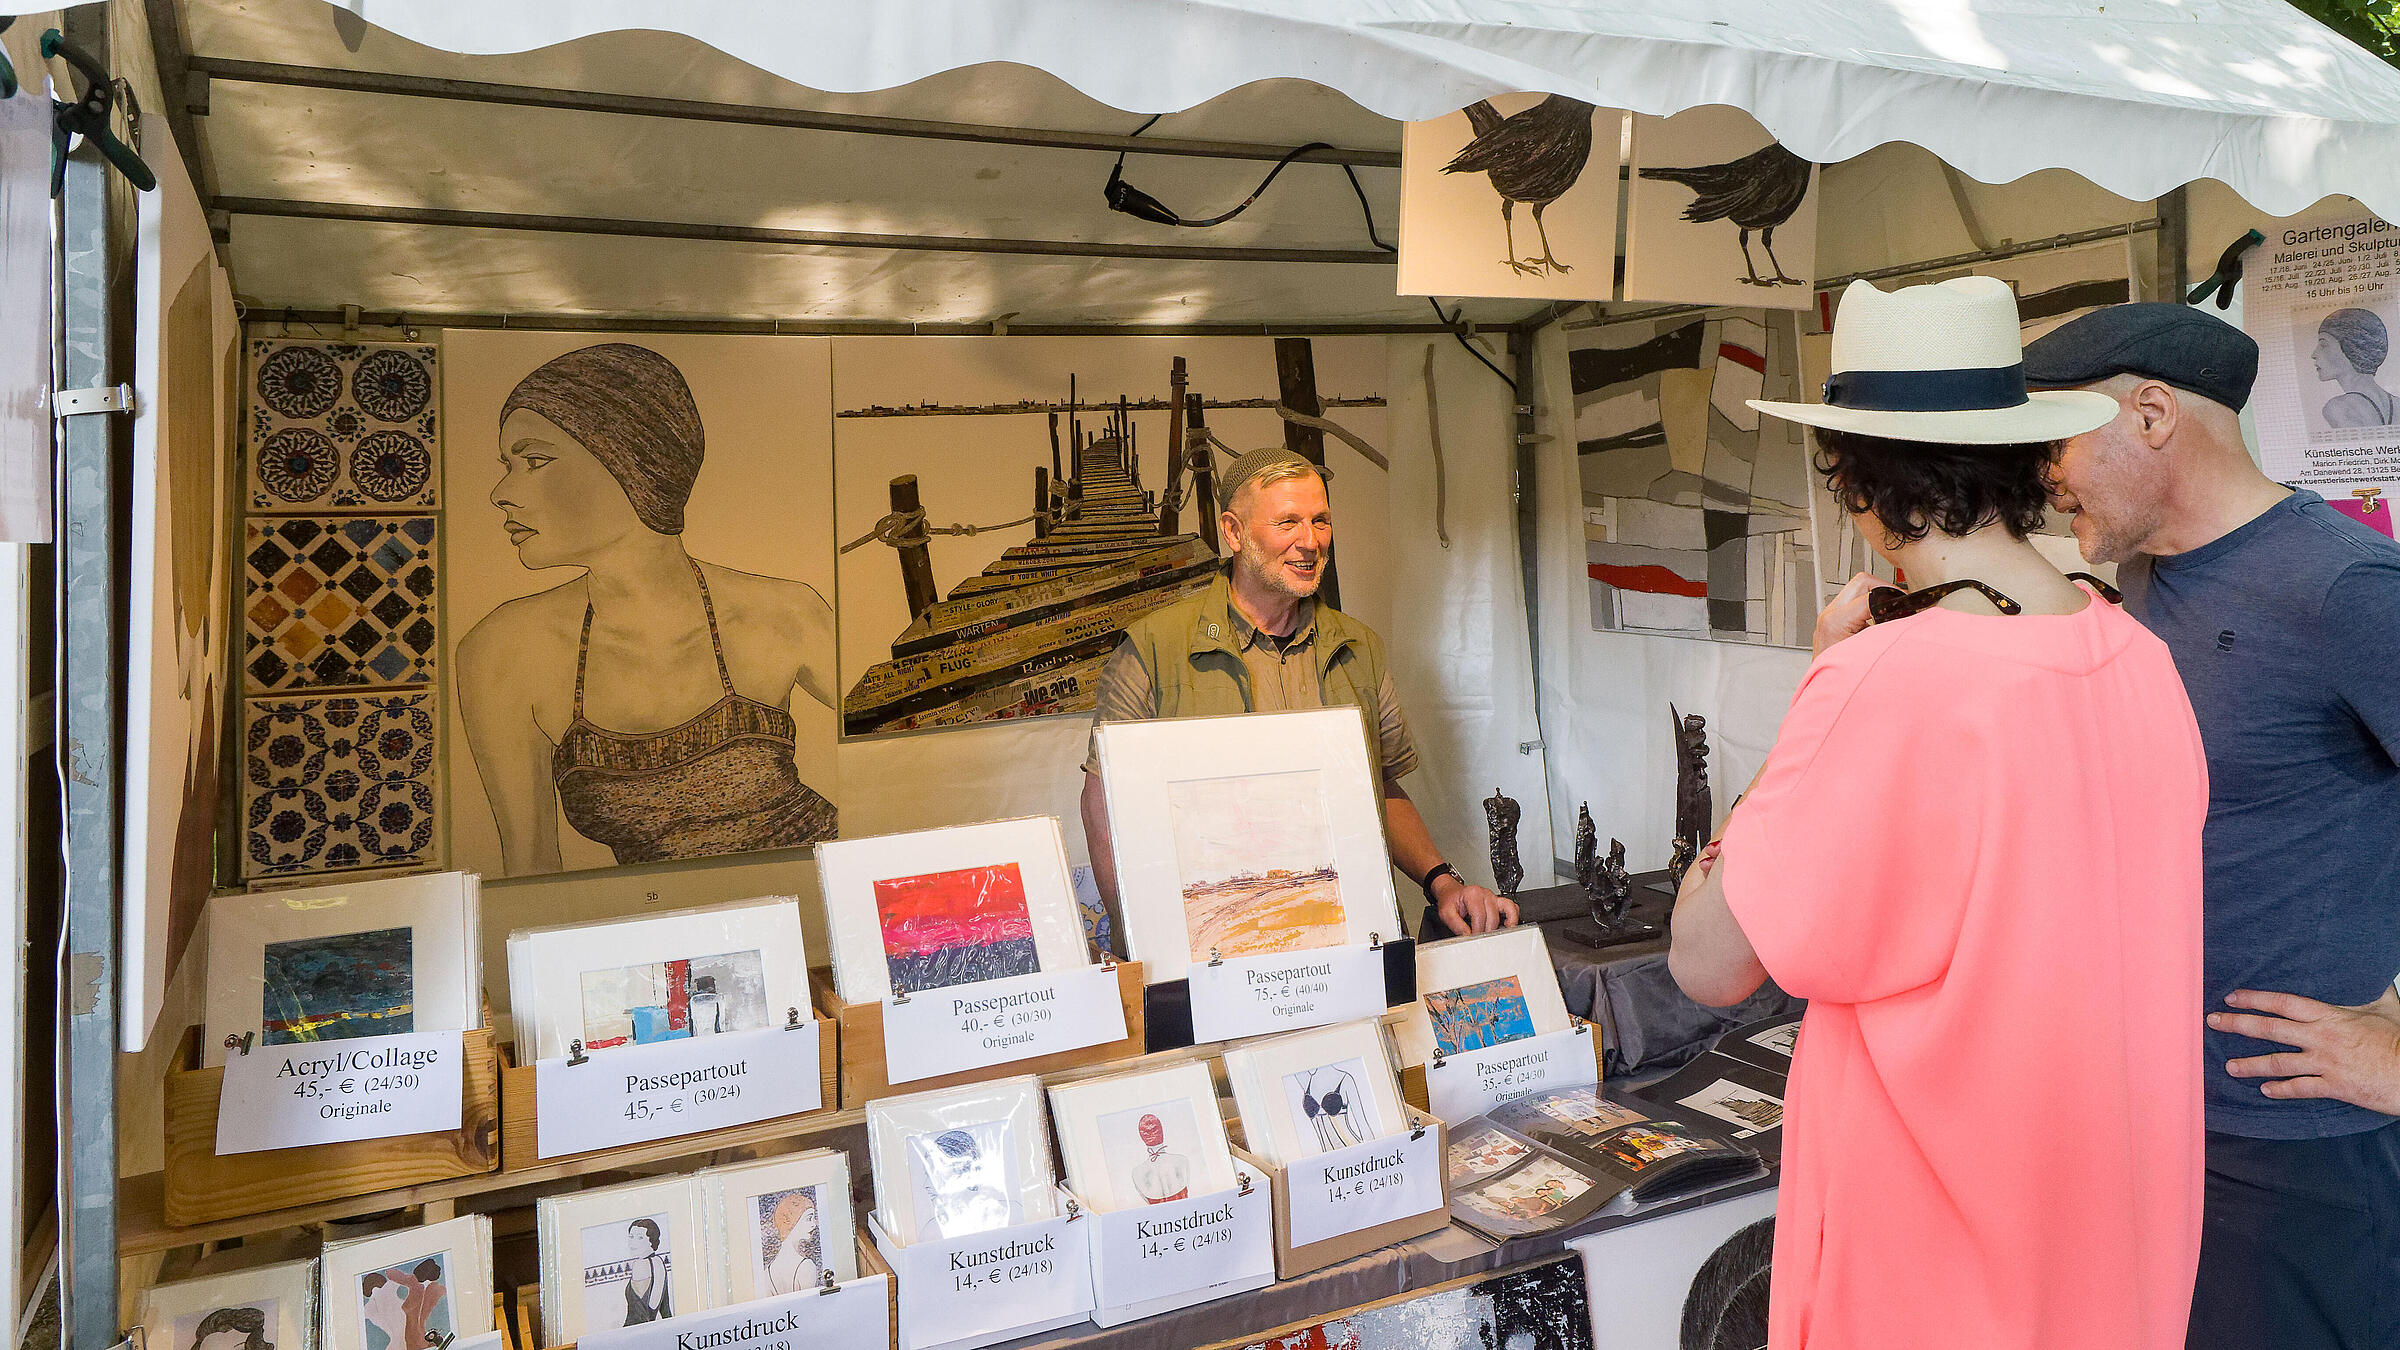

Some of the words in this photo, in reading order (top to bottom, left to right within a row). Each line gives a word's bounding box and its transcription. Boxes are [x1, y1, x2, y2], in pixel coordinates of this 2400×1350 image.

[2283, 218, 2398, 245] Gartengaler
[2274, 248, 2318, 264] Malerei
[2322, 245, 2344, 257] und
[2293, 264, 2308, 272] Juni
[2338, 258, 2353, 266] Juni
[2374, 270, 2392, 278] Aug.
[2306, 290, 2317, 299] 15
[2319, 288, 2335, 298] Uhr
[2337, 286, 2351, 296] bis
[2354, 284, 2365, 293] 19
[2367, 282, 2385, 292] Uhr
[2304, 446, 2373, 459] Künstlerische
[2374, 457, 2389, 465] Dirk
[2367, 466, 2389, 474] 13125
[1040, 569, 1058, 579] WHITE
[950, 602, 971, 614] STYLE
[976, 598, 999, 609] GLORY
[884, 672, 895, 681] ALL
[1246, 962, 1332, 985] Passepartout
[1281, 985, 1290, 998] €
[1295, 982, 1328, 998] (40/40)
[952, 985, 1056, 1016] Passepartout
[1272, 1002, 1314, 1017] Originale
[993, 1014, 1005, 1028] €
[1011, 1008, 1052, 1027] (30/30)
[982, 1030, 1035, 1050] Originale
[276, 1048, 438, 1079] Acryl/Collage
[1476, 1049, 1549, 1077] Passepartout
[625, 1058, 748, 1094] Passepartout
[1504, 1074, 1513, 1086] €
[1516, 1068, 1545, 1085] (24/30)
[293, 1081, 332, 1100] 45,-
[339, 1078, 355, 1094] €
[364, 1074, 419, 1095] (24/30)
[1495, 1087, 1533, 1103] Originale
[320, 1099, 392, 1120] Originale
[624, 1099, 663, 1121] 45,-
[669, 1098, 684, 1113] €
[694, 1084, 742, 1106] (30/24)
[1323, 1149, 1404, 1184] Kunstdruck
[1329, 1185, 1351, 1202] 14,-
[1354, 1181, 1365, 1195] €
[1369, 1172, 1404, 1194] (24/18)
[1136, 1204, 1235, 1240] Kunstdruck
[949, 1233, 1055, 1272] Kunstdruck
[1141, 1242, 1169, 1259] 14,-
[1173, 1237, 1186, 1252] €
[1191, 1228, 1233, 1251] (24/18)
[955, 1274, 984, 1292] 14,-
[989, 1268, 1002, 1284] €
[1008, 1258, 1054, 1283] (24/18)
[676, 1310, 799, 1350] Kunstdruck
